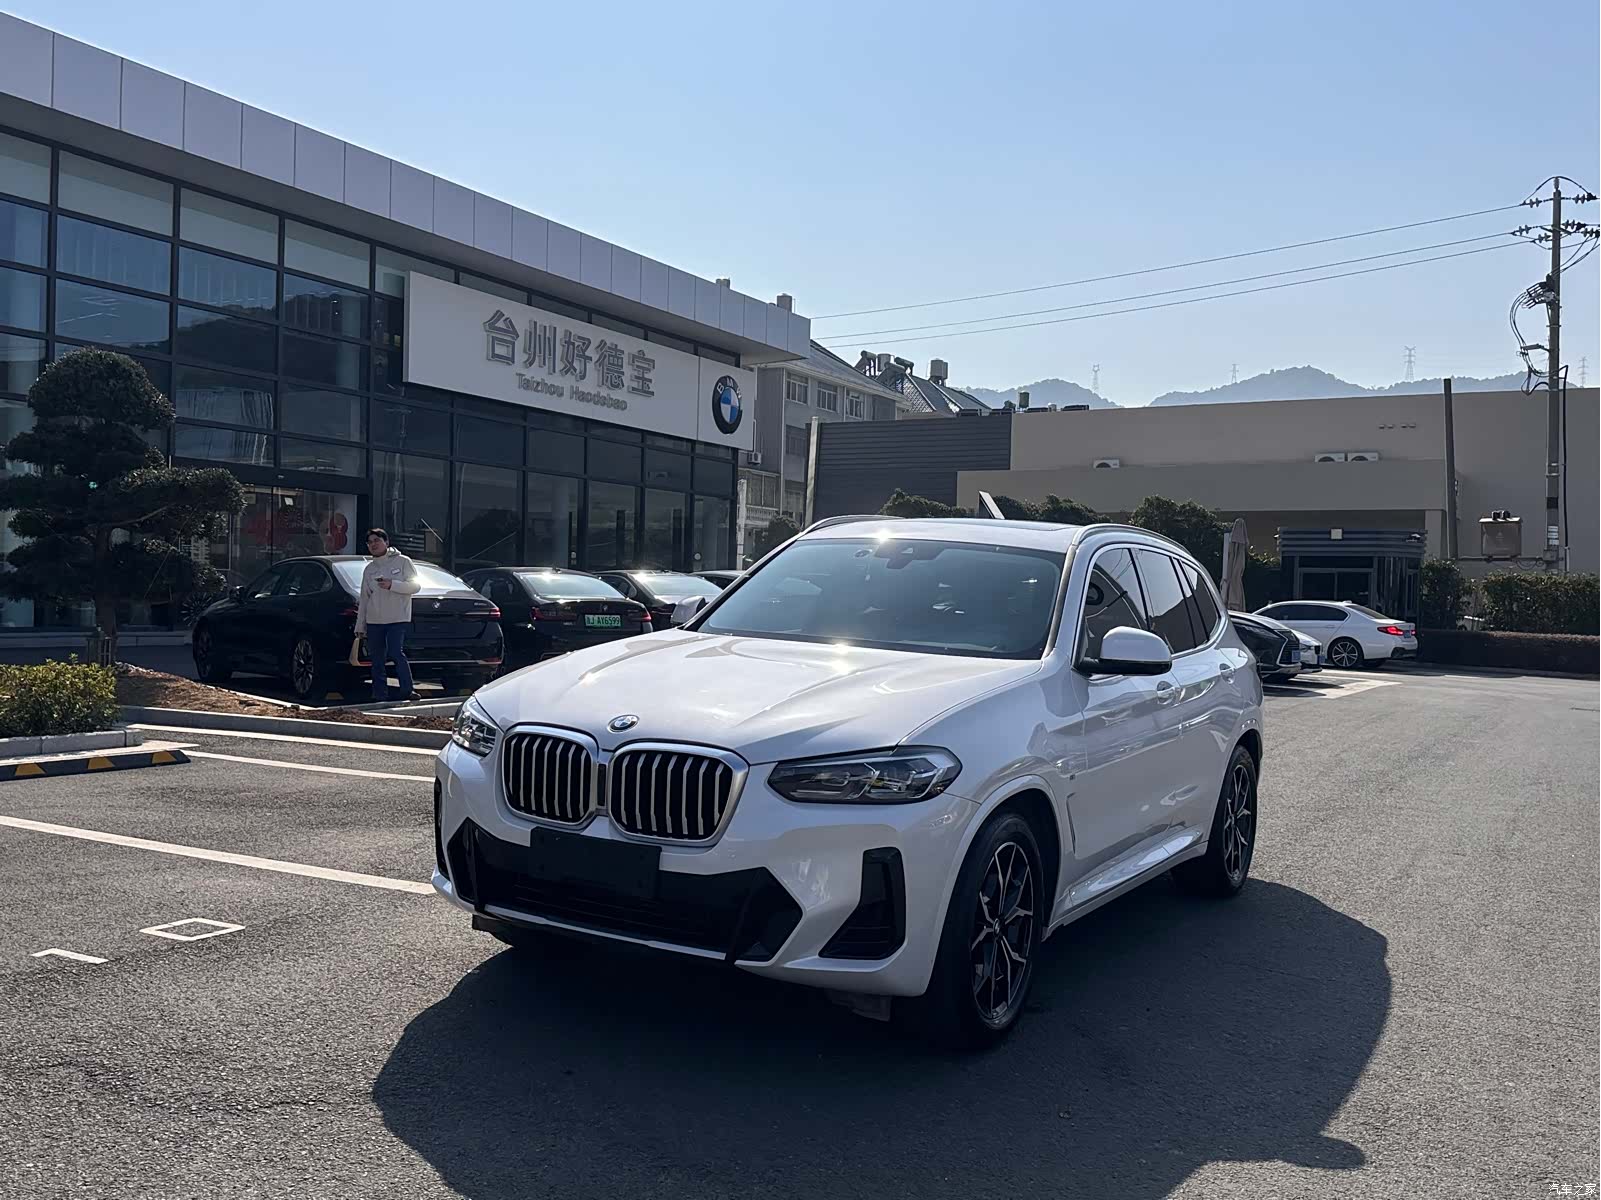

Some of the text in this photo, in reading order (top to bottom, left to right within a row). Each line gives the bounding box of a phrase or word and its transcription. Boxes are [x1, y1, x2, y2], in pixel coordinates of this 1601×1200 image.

[483, 309, 656, 397] 台州好德宝
[515, 372, 565, 398] Taizhou
